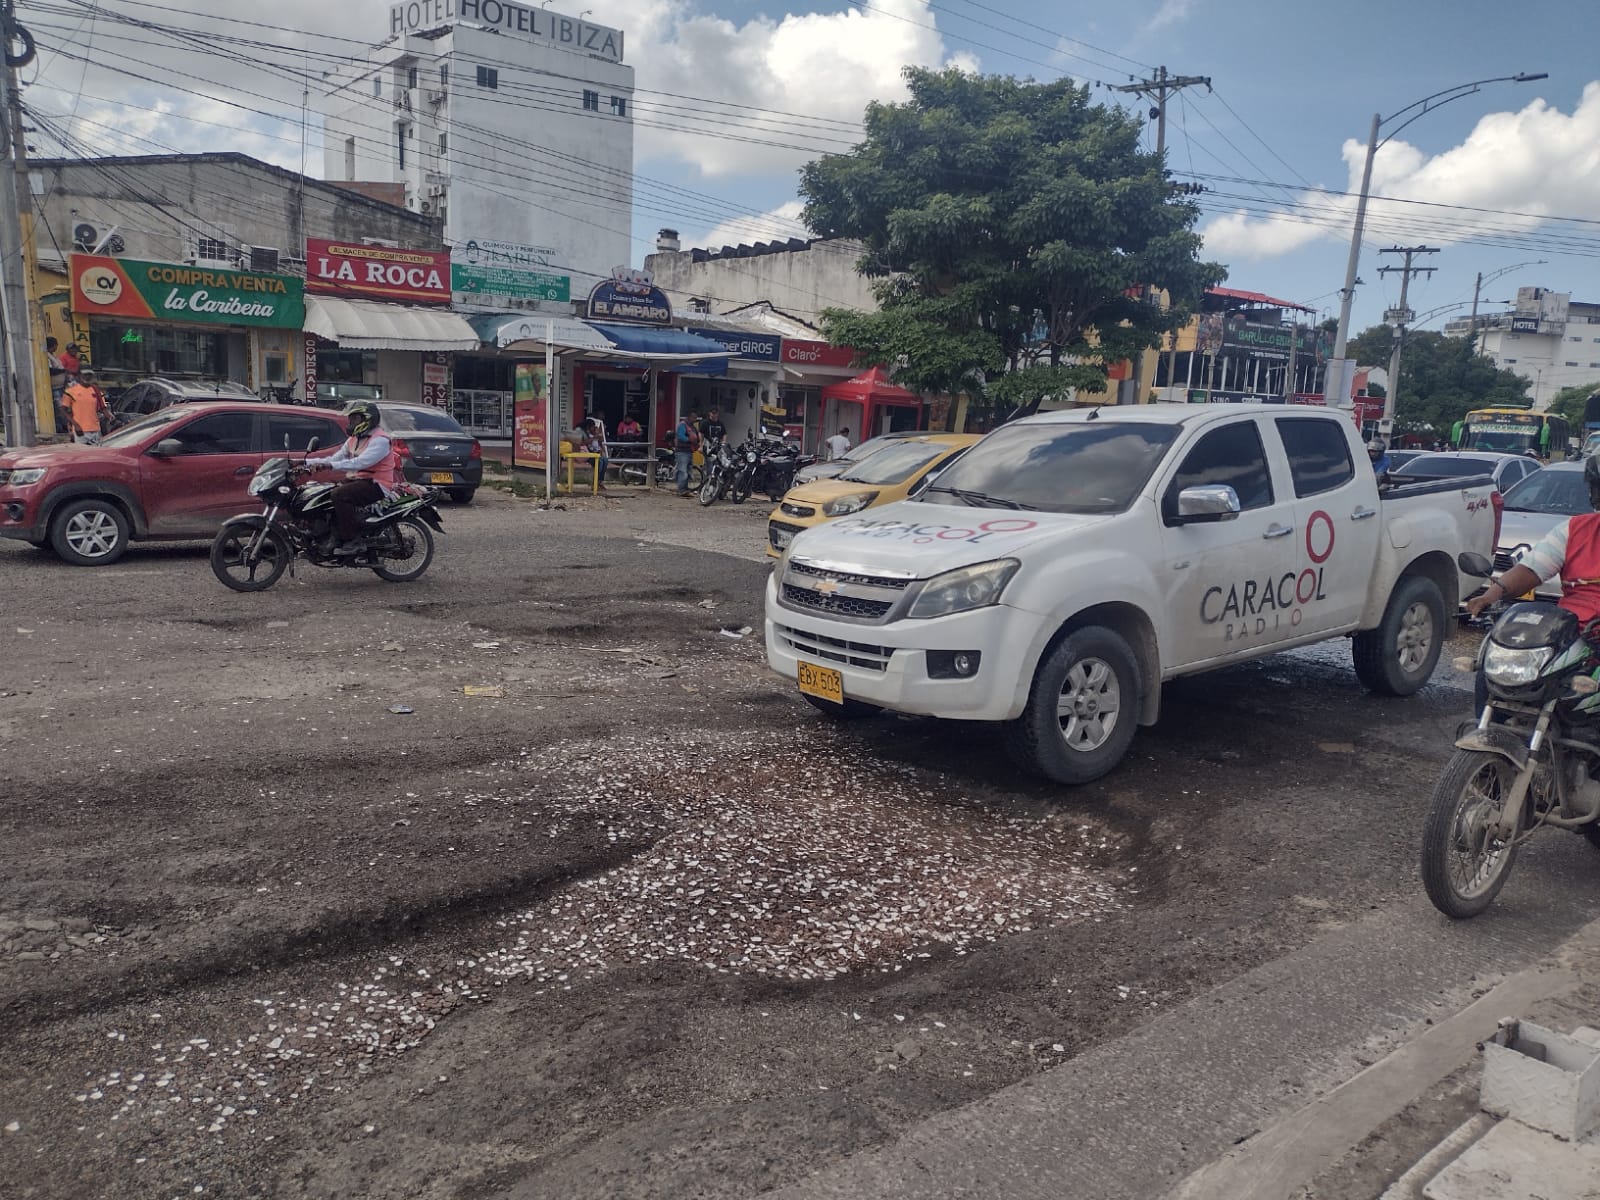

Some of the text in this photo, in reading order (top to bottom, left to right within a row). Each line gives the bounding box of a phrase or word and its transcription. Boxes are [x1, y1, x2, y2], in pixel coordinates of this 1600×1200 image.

[461, 0, 618, 57] HOTEL IBIZA
[147, 267, 287, 294] COMPRA VENTA
[318, 258, 356, 280] LA
[366, 263, 443, 288] ROCA
[595, 301, 669, 320] EL AMPARO
[1513, 320, 1537, 330] HOTEL
[740, 340, 774, 354] GIROS
[788, 347, 818, 361] Claro
[1201, 567, 1326, 624] CARACOL
[1225, 608, 1302, 641] RADIO
[800, 665, 840, 694] EBX 503
